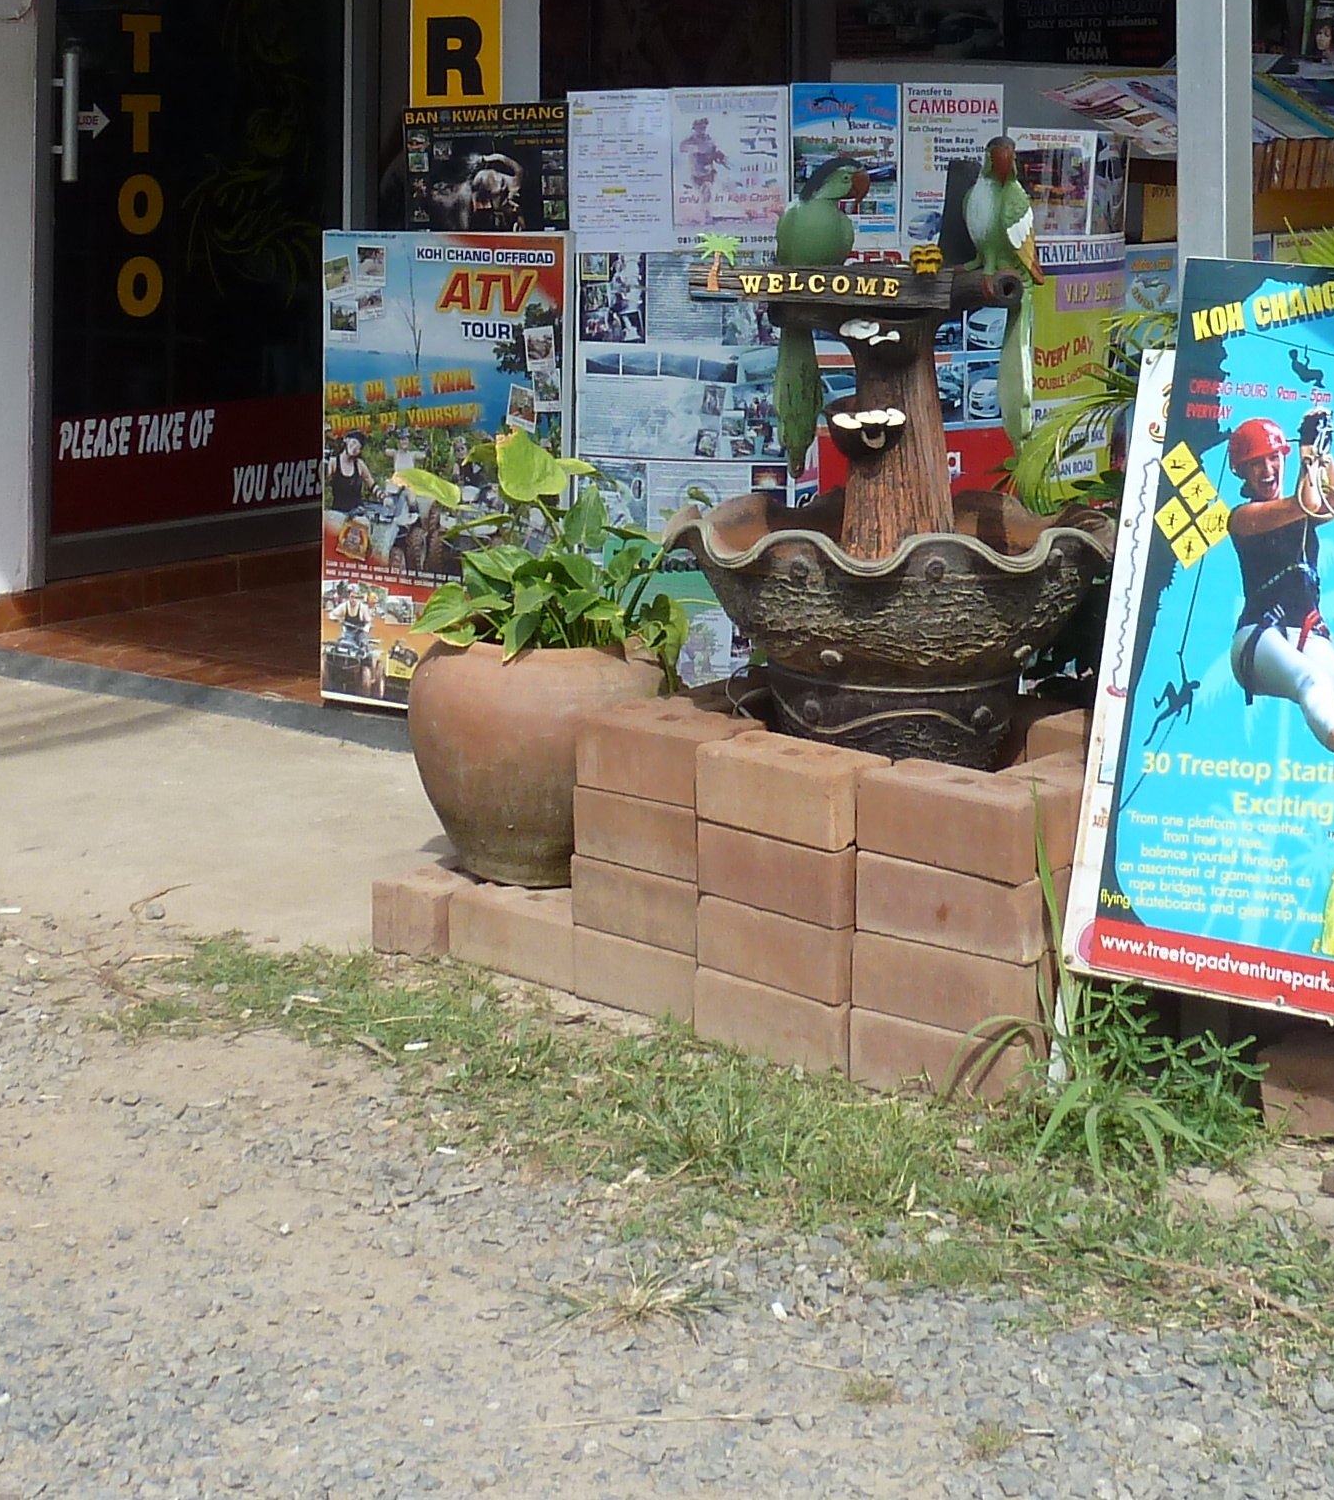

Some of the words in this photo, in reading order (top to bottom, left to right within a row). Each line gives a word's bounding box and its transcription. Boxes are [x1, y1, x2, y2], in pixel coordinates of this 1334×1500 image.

[907, 88, 941, 96] Transfer
[944, 88, 952, 96] to
[405, 111, 438, 125] BAN
[452, 108, 498, 122] KWAN
[502, 106, 565, 120] CHANG
[908, 99, 998, 114] CAMBODIA
[417, 248, 441, 260] KOH
[447, 250, 490, 262] CHANG
[496, 252, 553, 264] OFFROAD
[439, 271, 535, 312] ATV
[739, 271, 901, 298] WELCOME
[461, 321, 510, 340] TOUR
[1192, 302, 1244, 341] KOH
[1034, 342, 1070, 368] EVERY
[394, 374, 423, 397] THE
[1189, 378, 1233, 396] OPENING
[1236, 383, 1268, 398] HOURS
[1277, 386, 1297, 401] 9am
[1310, 388, 1331, 406] 5pm
[1185, 402, 1233, 419] EVERYDAY
[59, 415, 132, 461] PLEASE
[138, 412, 184, 454] TAKE
[190, 409, 215, 447] OF
[232, 463, 267, 504] YOU
[1141, 752, 1171, 774] 30
[1176, 753, 1271, 785] Treetop
[1232, 791, 1334, 826] Exciting
[1187, 814, 1237, 831] platform
[1141, 844, 1187, 860] balance
[1192, 848, 1239, 865] yourself
[1138, 864, 1200, 878] assortment
[1221, 870, 1261, 885] games
[1100, 888, 1131, 909] flying
[1136, 896, 1206, 913] skateboards
